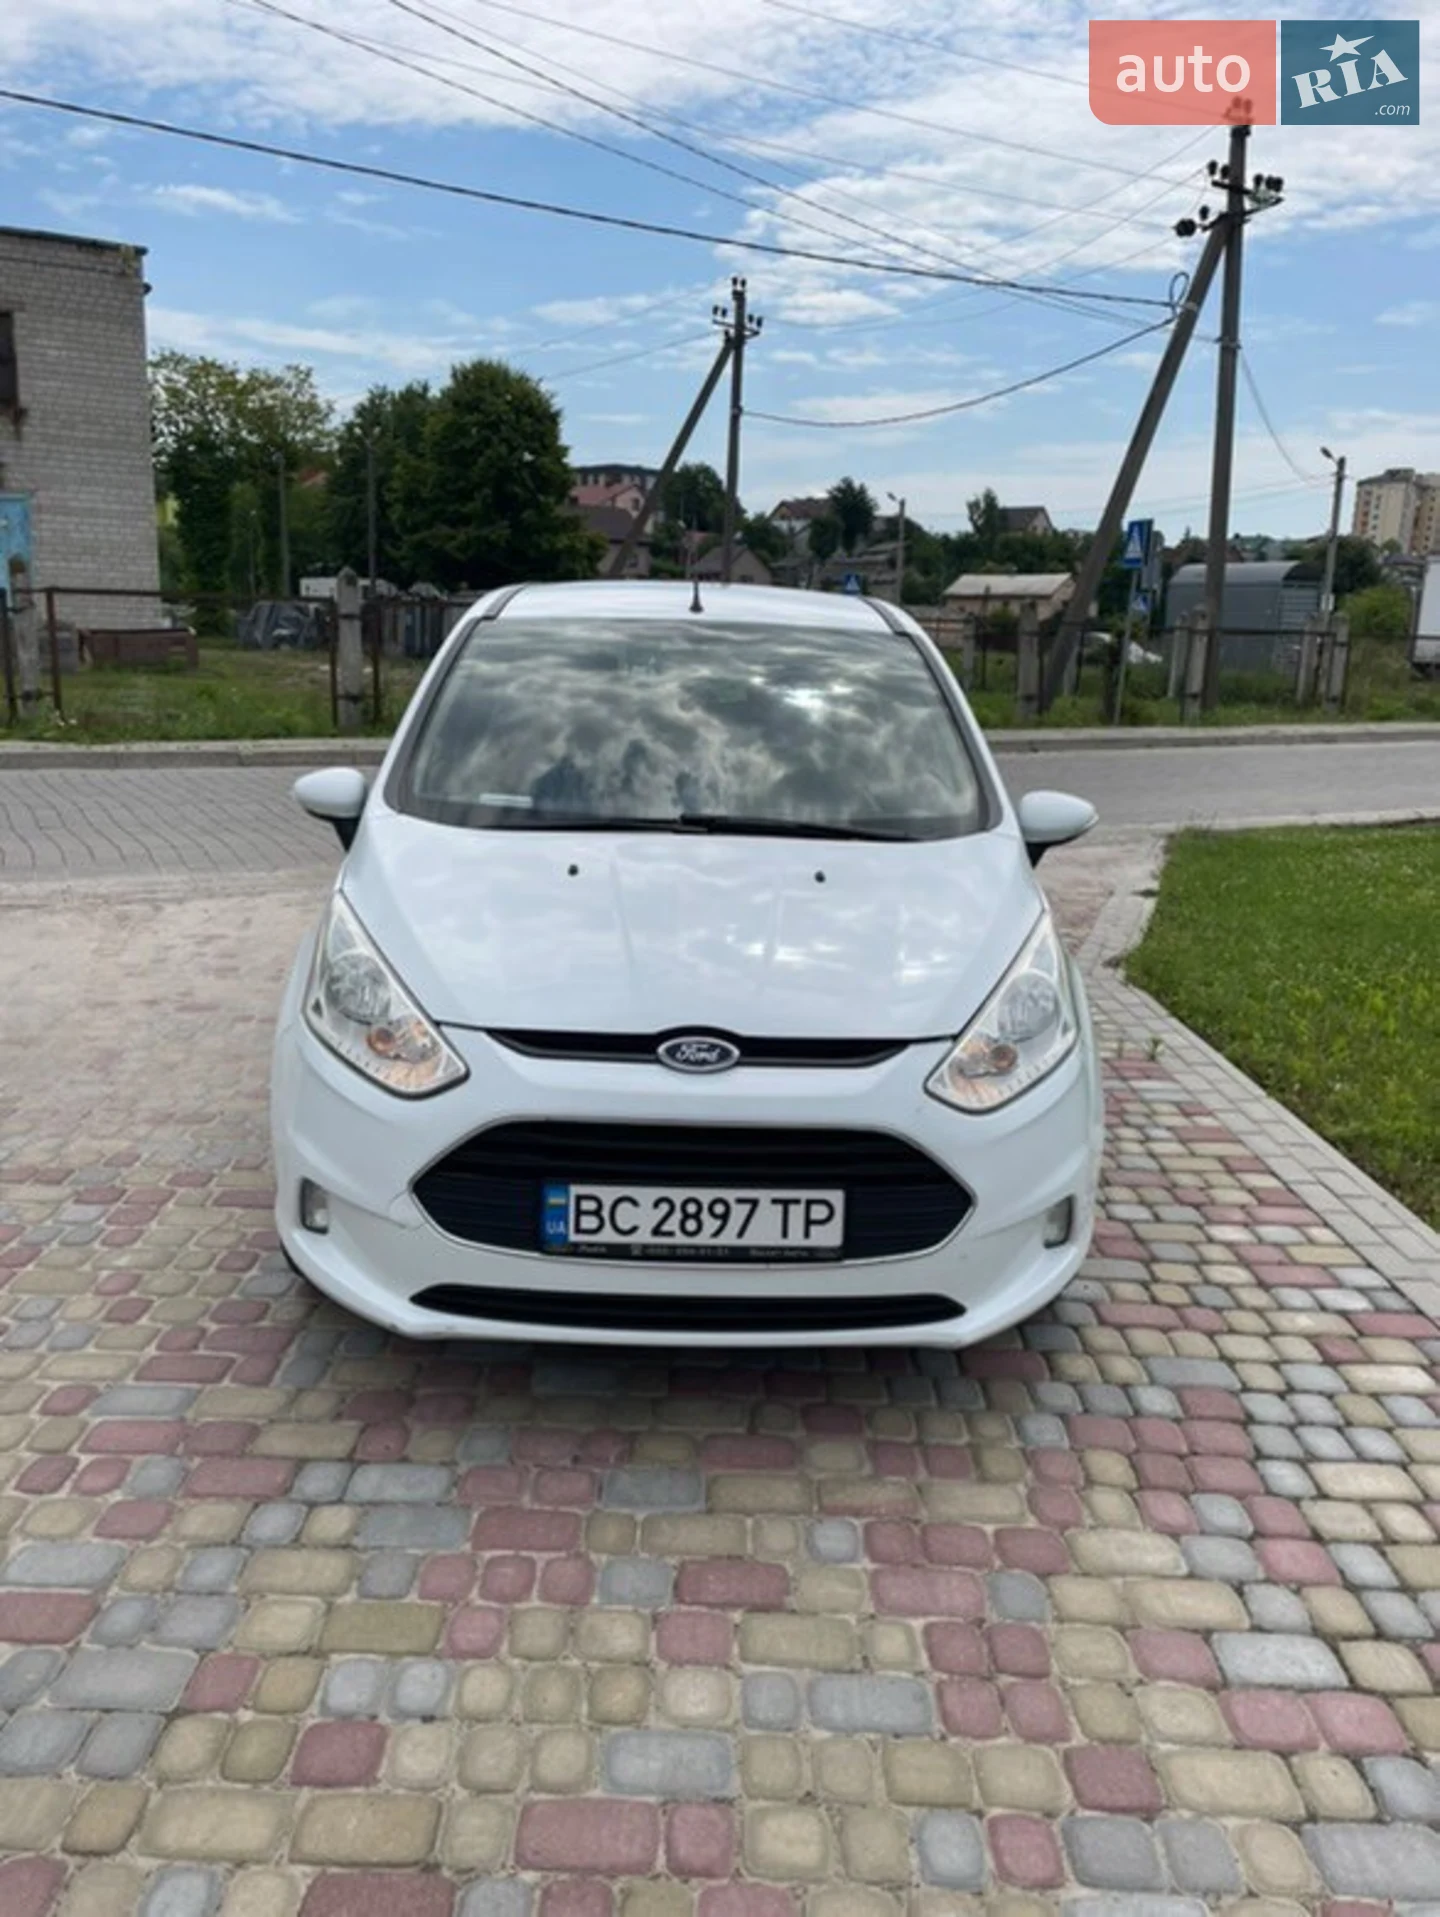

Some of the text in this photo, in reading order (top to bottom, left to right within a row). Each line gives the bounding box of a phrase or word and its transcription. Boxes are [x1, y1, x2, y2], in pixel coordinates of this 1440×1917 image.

[675, 1043, 721, 1062] Ford
[573, 1194, 835, 1240] BC 2897 TP
[545, 1220, 566, 1235] UA
